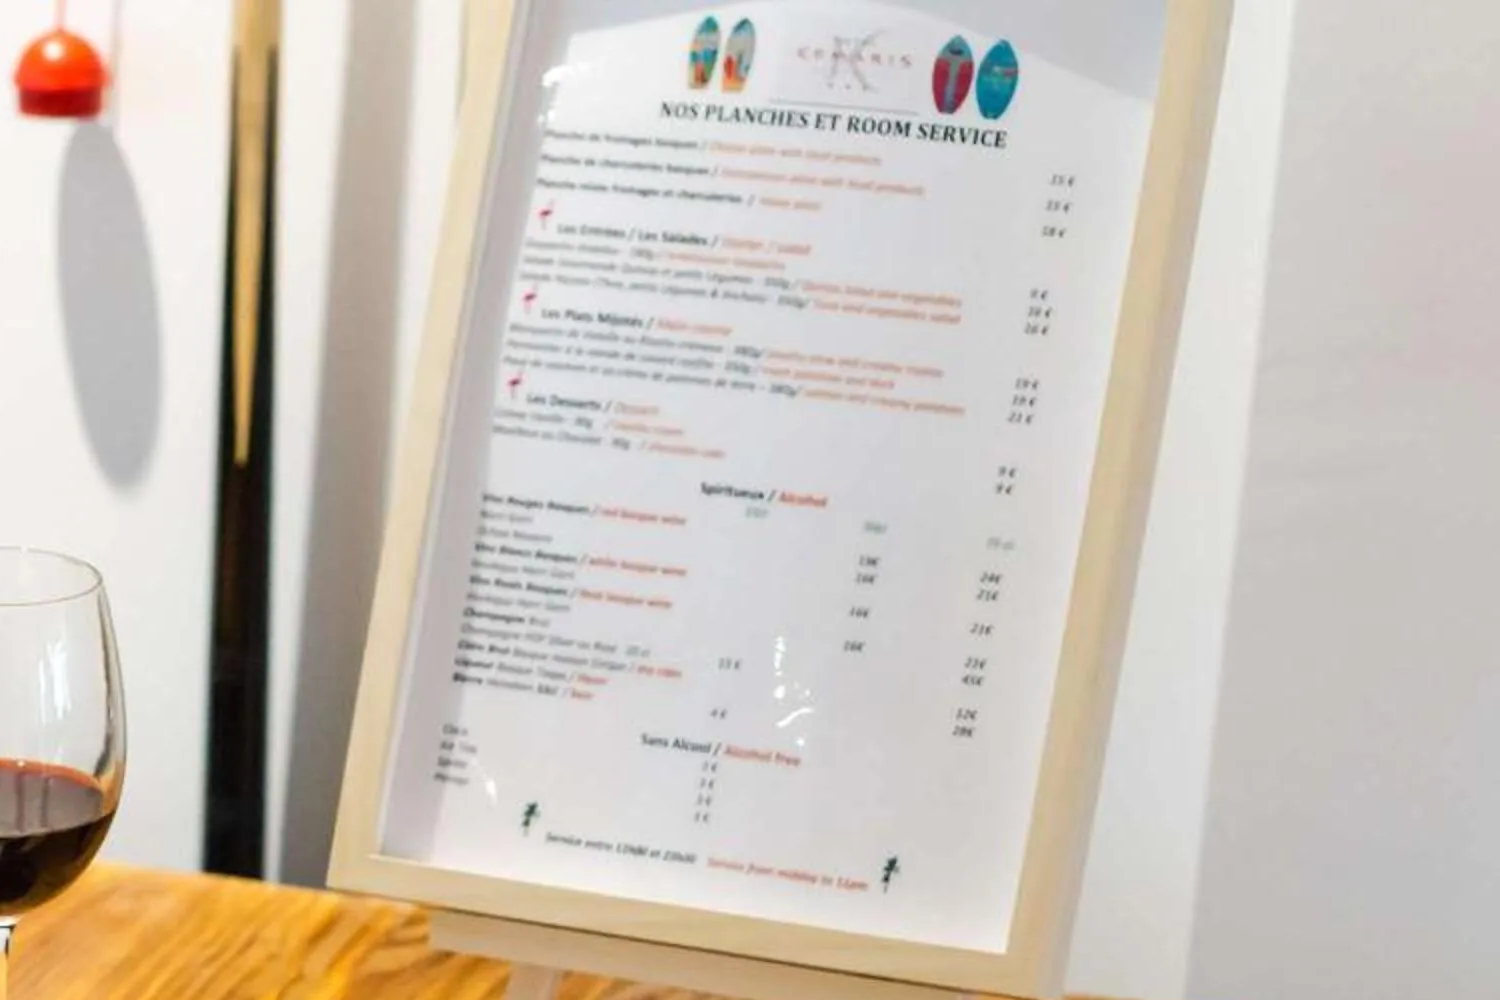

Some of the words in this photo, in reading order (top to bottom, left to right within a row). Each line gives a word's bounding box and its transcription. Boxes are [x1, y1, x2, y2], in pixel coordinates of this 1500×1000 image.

[660, 101, 700, 120] NOS
[705, 104, 808, 129] PLANCHES
[814, 113, 841, 131] ET
[847, 115, 911, 138] ROOM
[916, 122, 1007, 150] SERVICE
[701, 482, 765, 501] Spiritueux
[641, 732, 668, 747] Sans
[672, 737, 712, 753] Alcool
